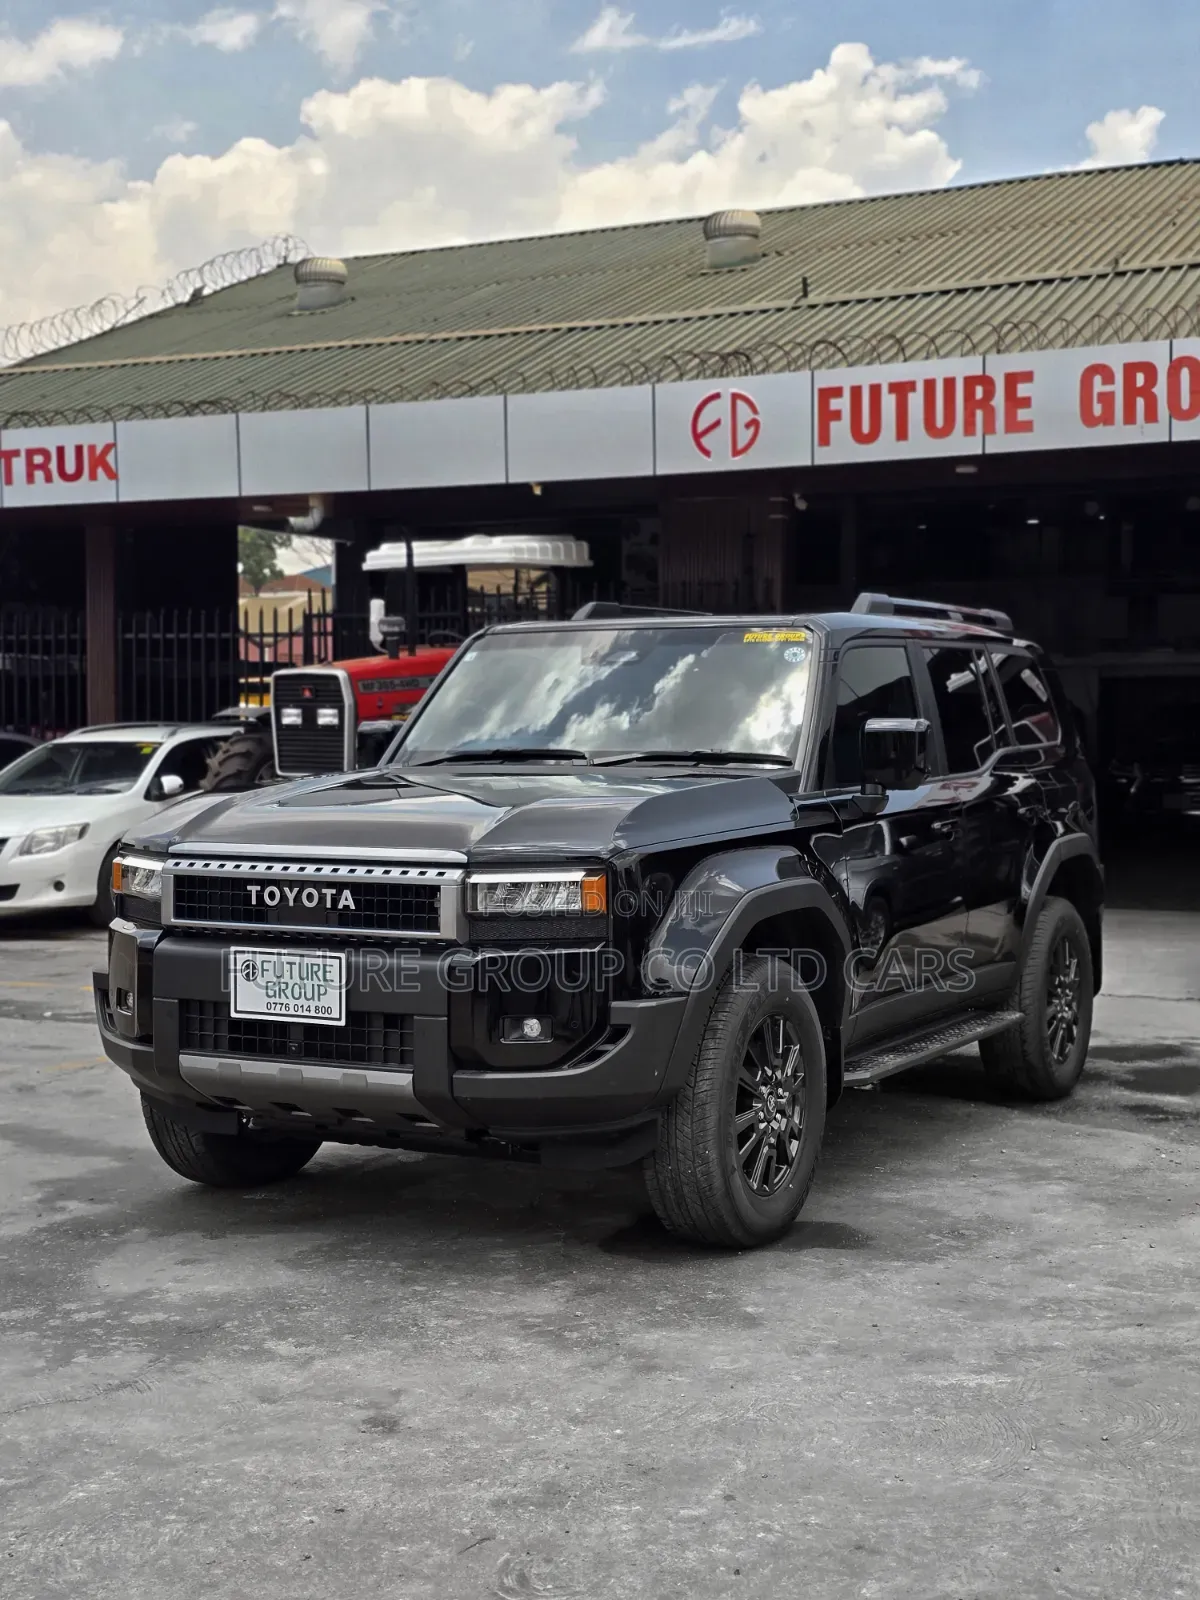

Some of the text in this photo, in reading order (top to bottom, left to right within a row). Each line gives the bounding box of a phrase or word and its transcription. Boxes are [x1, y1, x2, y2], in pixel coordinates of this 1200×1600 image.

[817, 355, 1200, 447] FUTURE GRO
[0, 442, 118, 487] TRUK
[246, 885, 356, 910] TOYOTA
[261, 960, 334, 982] FUTURE
[265, 981, 328, 1002] GROUP
[266, 1001, 332, 1015] 0776 014 800
